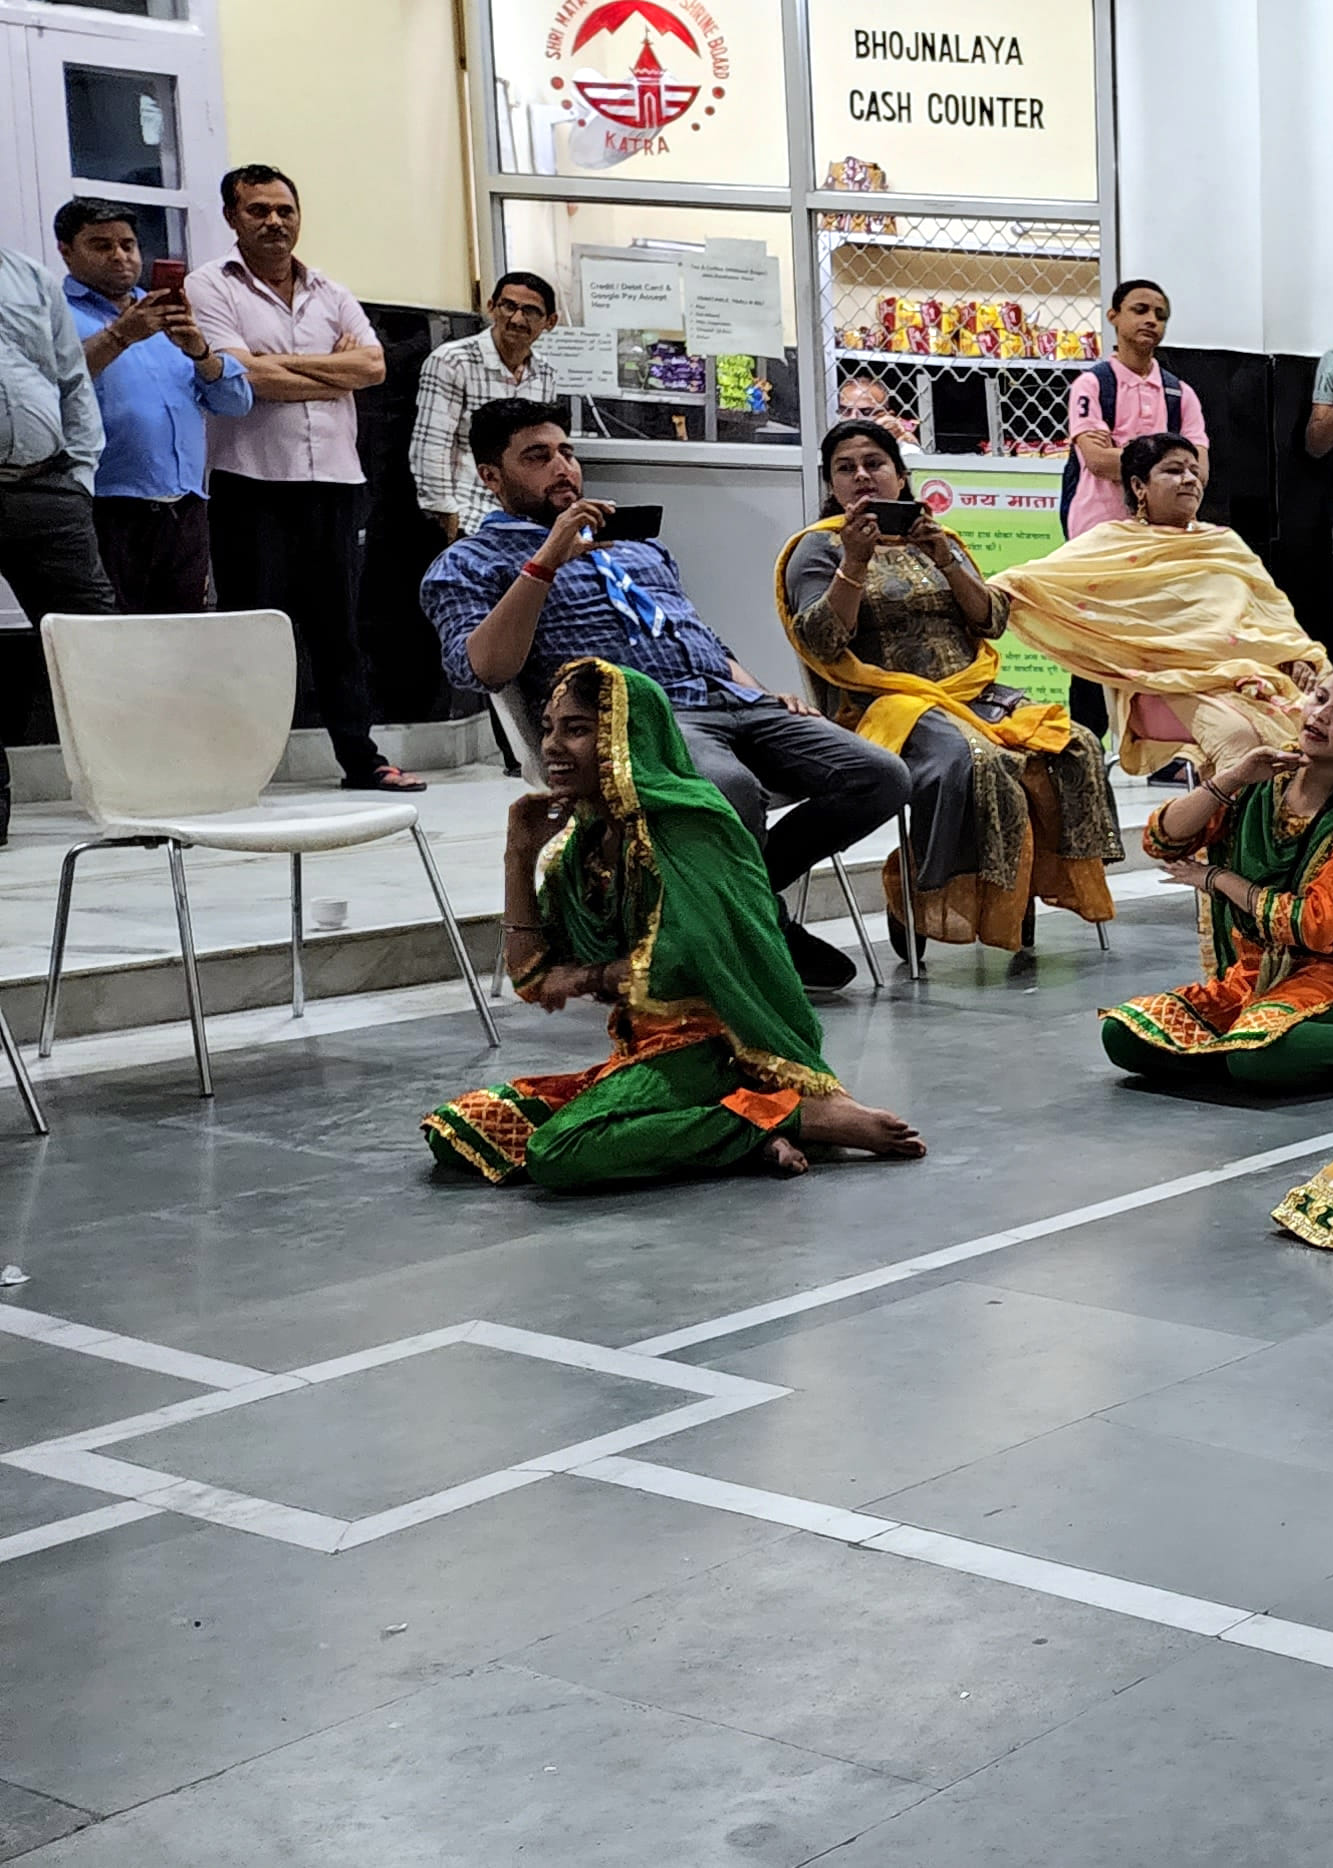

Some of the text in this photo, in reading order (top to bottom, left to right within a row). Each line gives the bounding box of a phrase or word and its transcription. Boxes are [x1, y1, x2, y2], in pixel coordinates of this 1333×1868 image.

[546, 28, 565, 60] SHRI
[708, 36, 730, 80] BOARD
[855, 29, 1024, 65] BHOJNALAYA
[849, 90, 1045, 129] CASH COUNTER
[605, 130, 670, 156] KATRA
[590, 282, 614, 290] Credit
[621, 282, 642, 290] Debit
[644, 283, 664, 291] Card
[590, 291, 620, 301] Google
[622, 292, 638, 302] Pay
[1077, 395, 1090, 418] 3
[958, 493, 1000, 507] जय
[1005, 494, 1059, 509] माता
